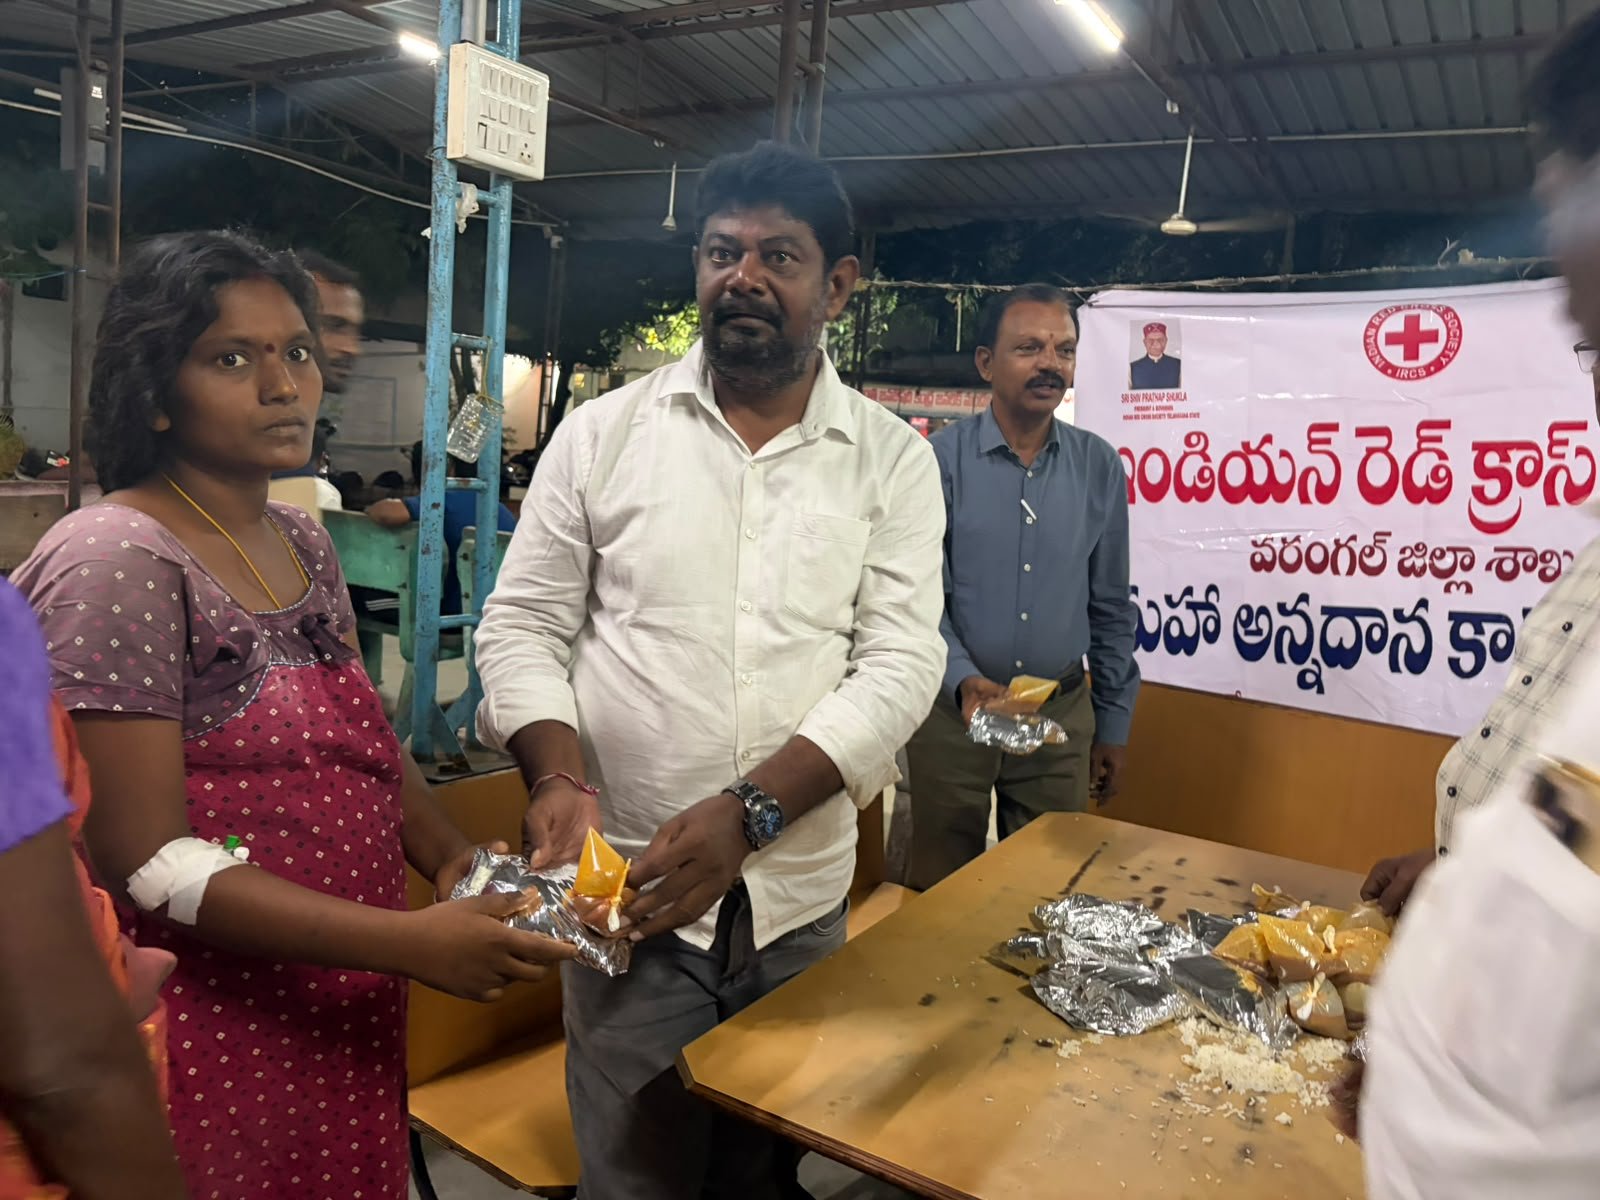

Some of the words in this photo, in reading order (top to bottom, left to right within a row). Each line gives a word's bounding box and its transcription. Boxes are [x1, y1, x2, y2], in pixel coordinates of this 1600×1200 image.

[1372, 306, 1396, 326] RED
[1440, 312, 1460, 366] SOCIETY
[1366, 328, 1385, 368] INDIAN
[1395, 367, 1427, 379] IRCS
[1355, 419, 1453, 506] రెడ్
[1468, 420, 1597, 535] క్రాస్
[1250, 531, 1392, 577] వరంగల్
[1397, 541, 1476, 594] జిల్లా
[1233, 592, 1433, 695] అన్నదాన
